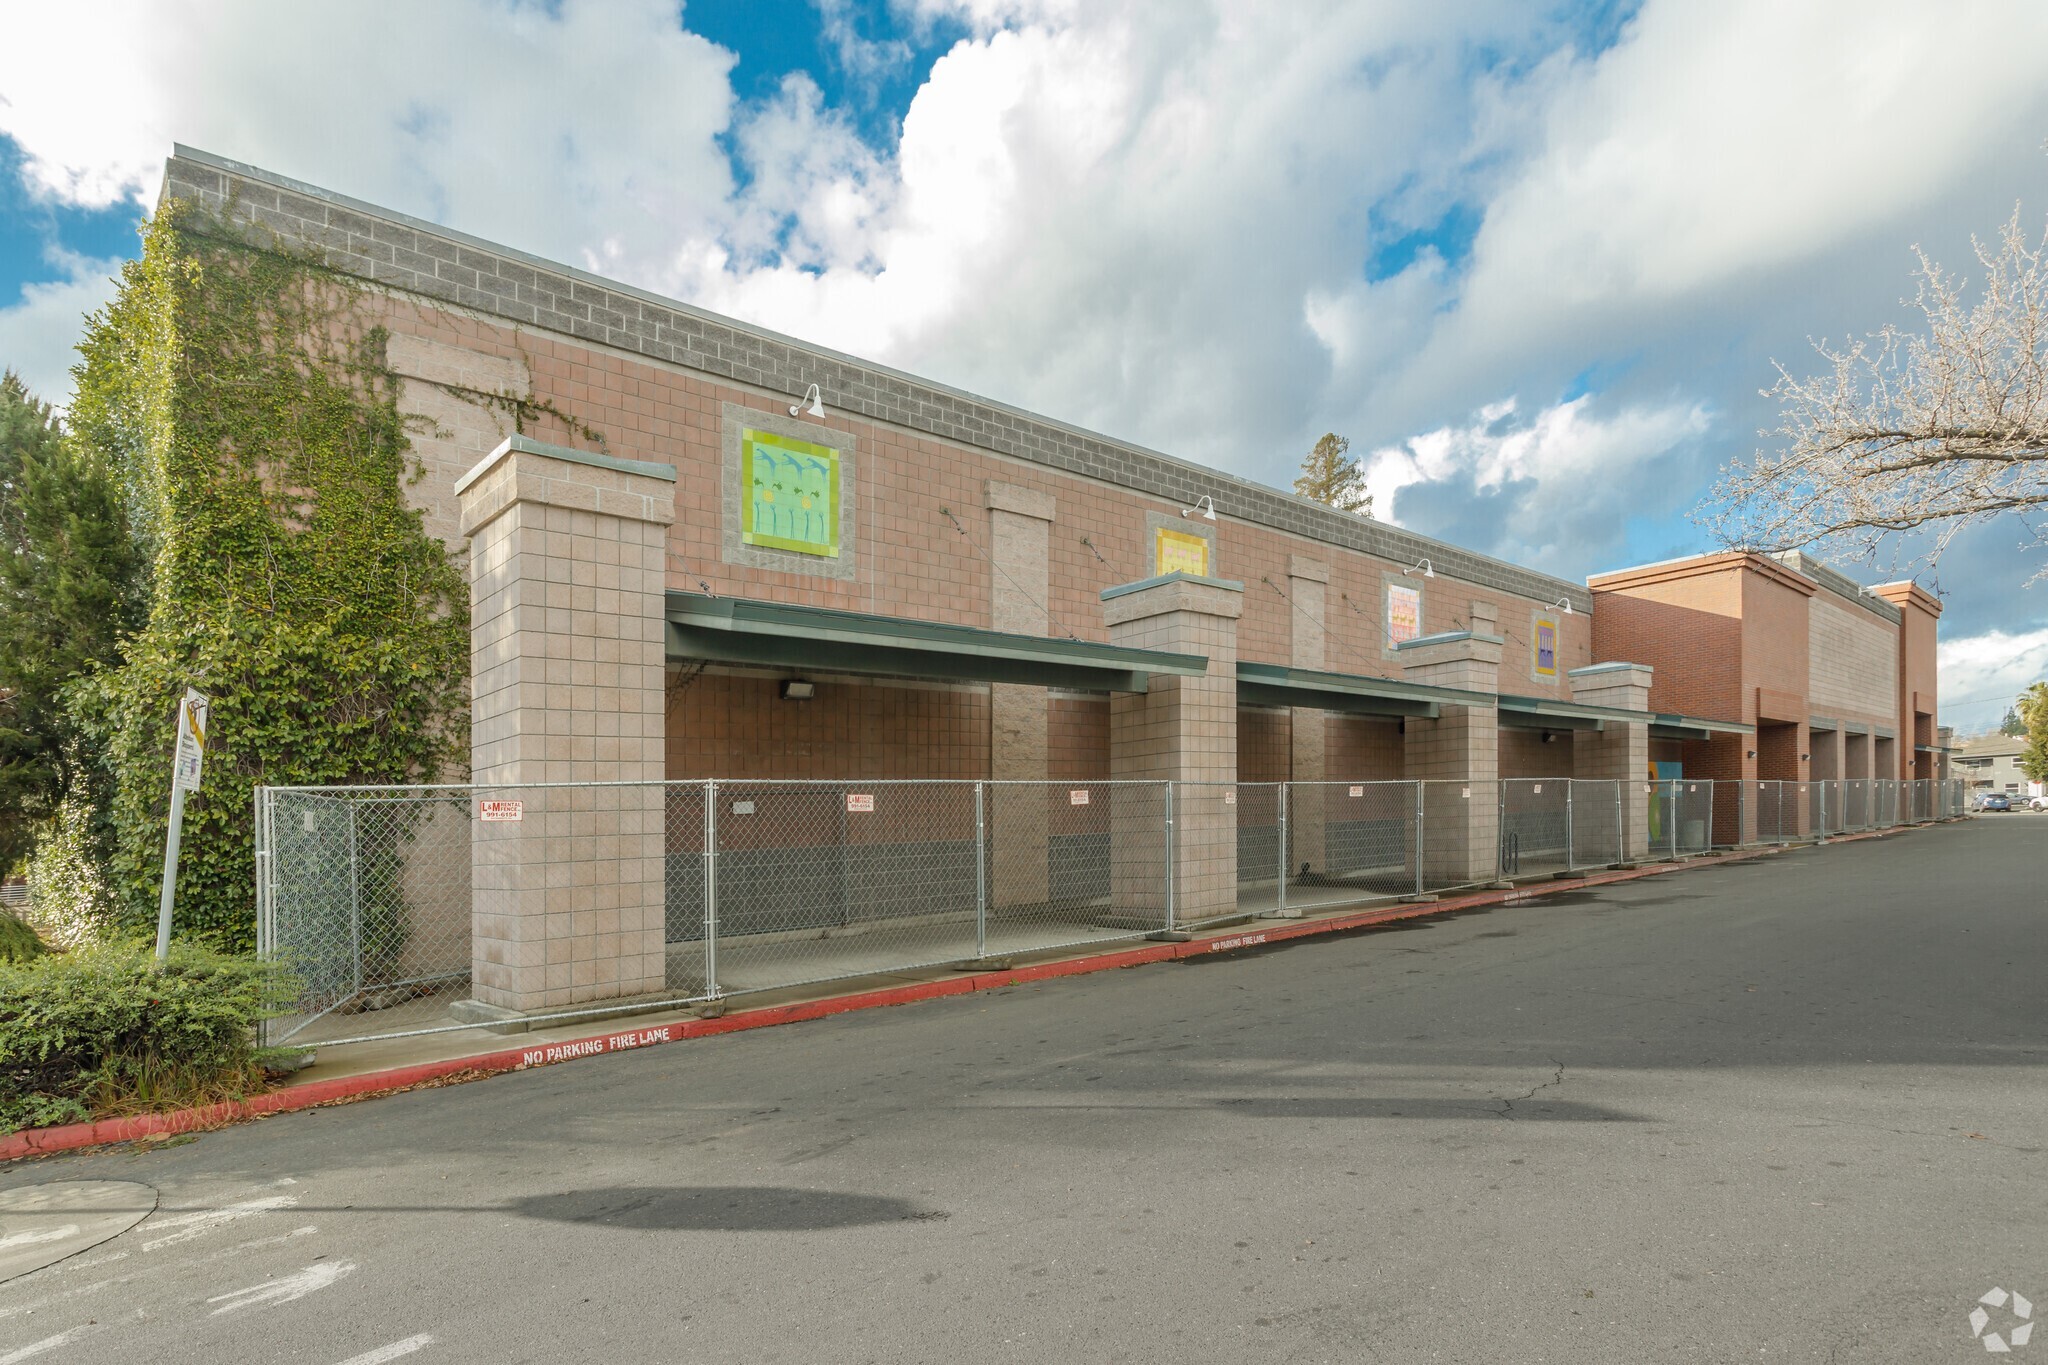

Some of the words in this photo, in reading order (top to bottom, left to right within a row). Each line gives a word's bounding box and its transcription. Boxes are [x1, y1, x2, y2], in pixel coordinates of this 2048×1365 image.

[1212, 942, 1219, 950] NO
[1220, 938, 1241, 949] PARKING
[1243, 936, 1253, 945] FIRE
[1253, 934, 1266, 943] LANE
[523, 1051, 543, 1066] NO
[547, 1039, 603, 1062] PARKING
[610, 1033, 637, 1050] FIRE
[639, 1028, 670, 1044] LANE
